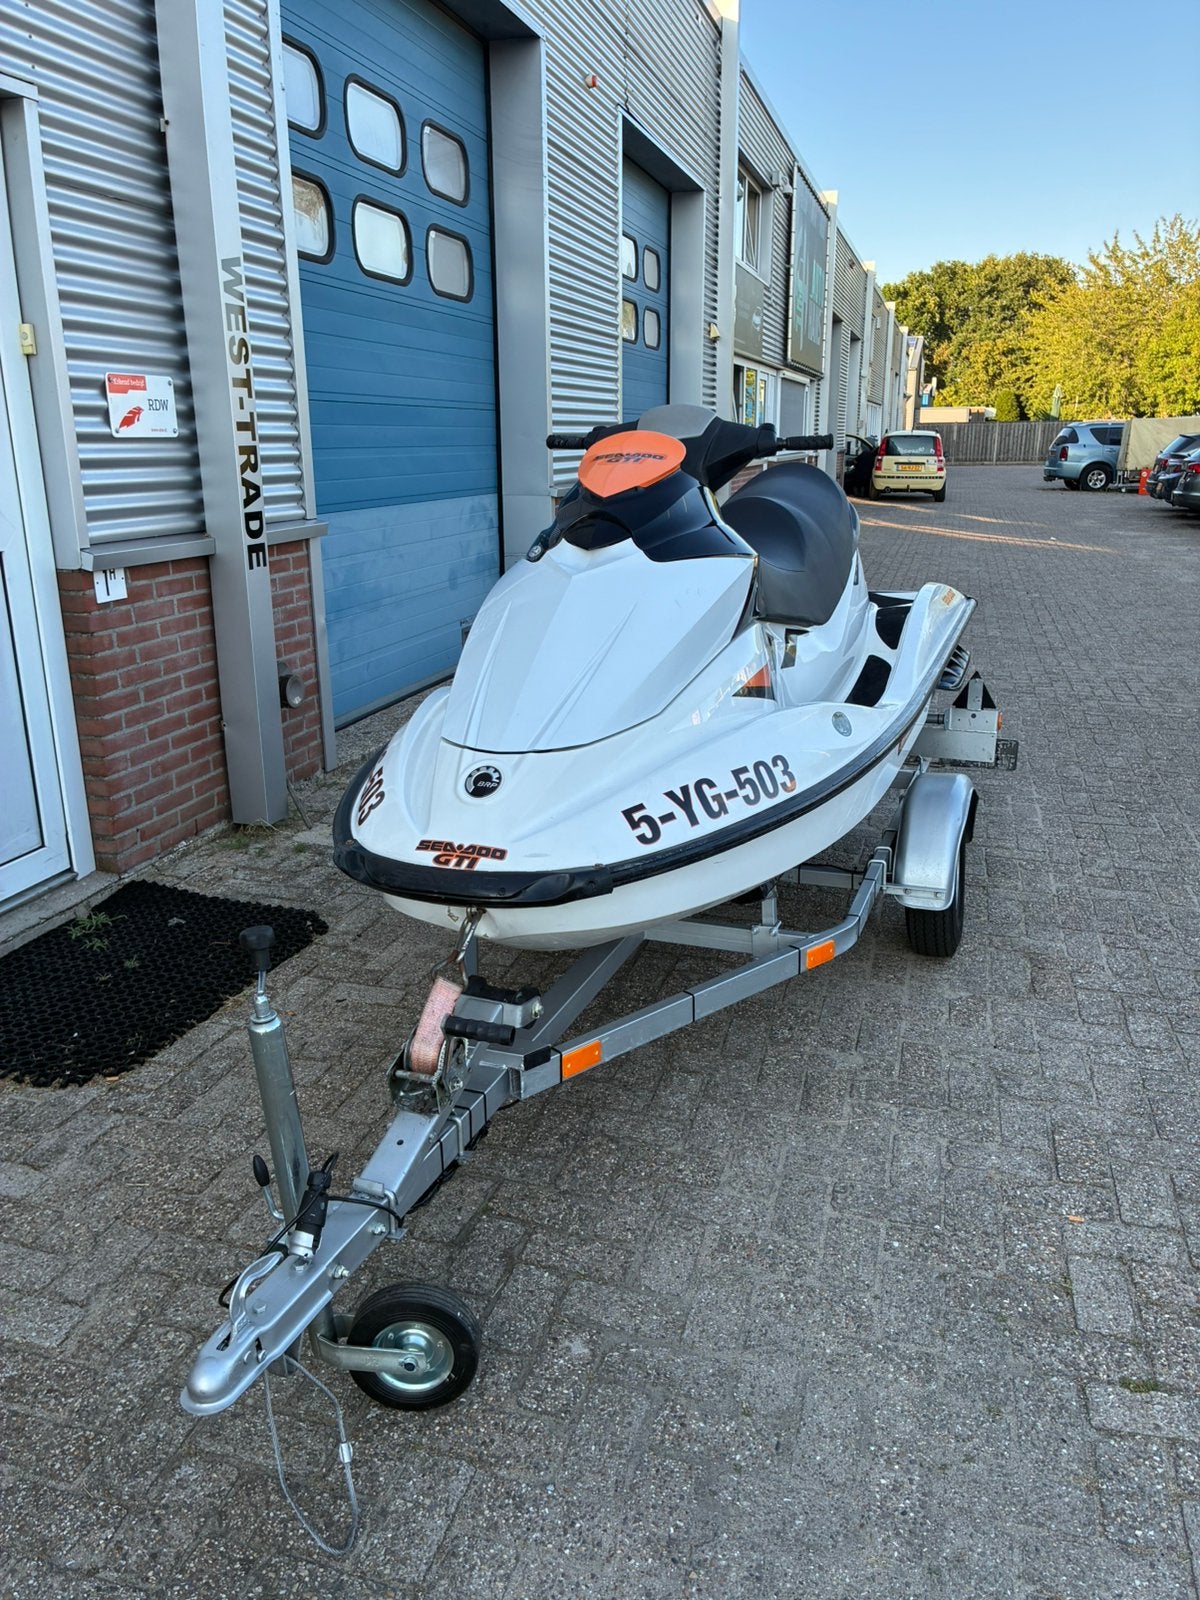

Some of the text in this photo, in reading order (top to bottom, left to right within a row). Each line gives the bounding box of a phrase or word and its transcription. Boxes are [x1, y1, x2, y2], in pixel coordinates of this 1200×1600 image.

[147, 398, 169, 411] RDW
[220, 256, 267, 571] WEST-TRADE
[476, 780, 498, 789] BRP
[620, 754, 797, 846] 5-YG-503
[432, 853, 479, 871] GTI
